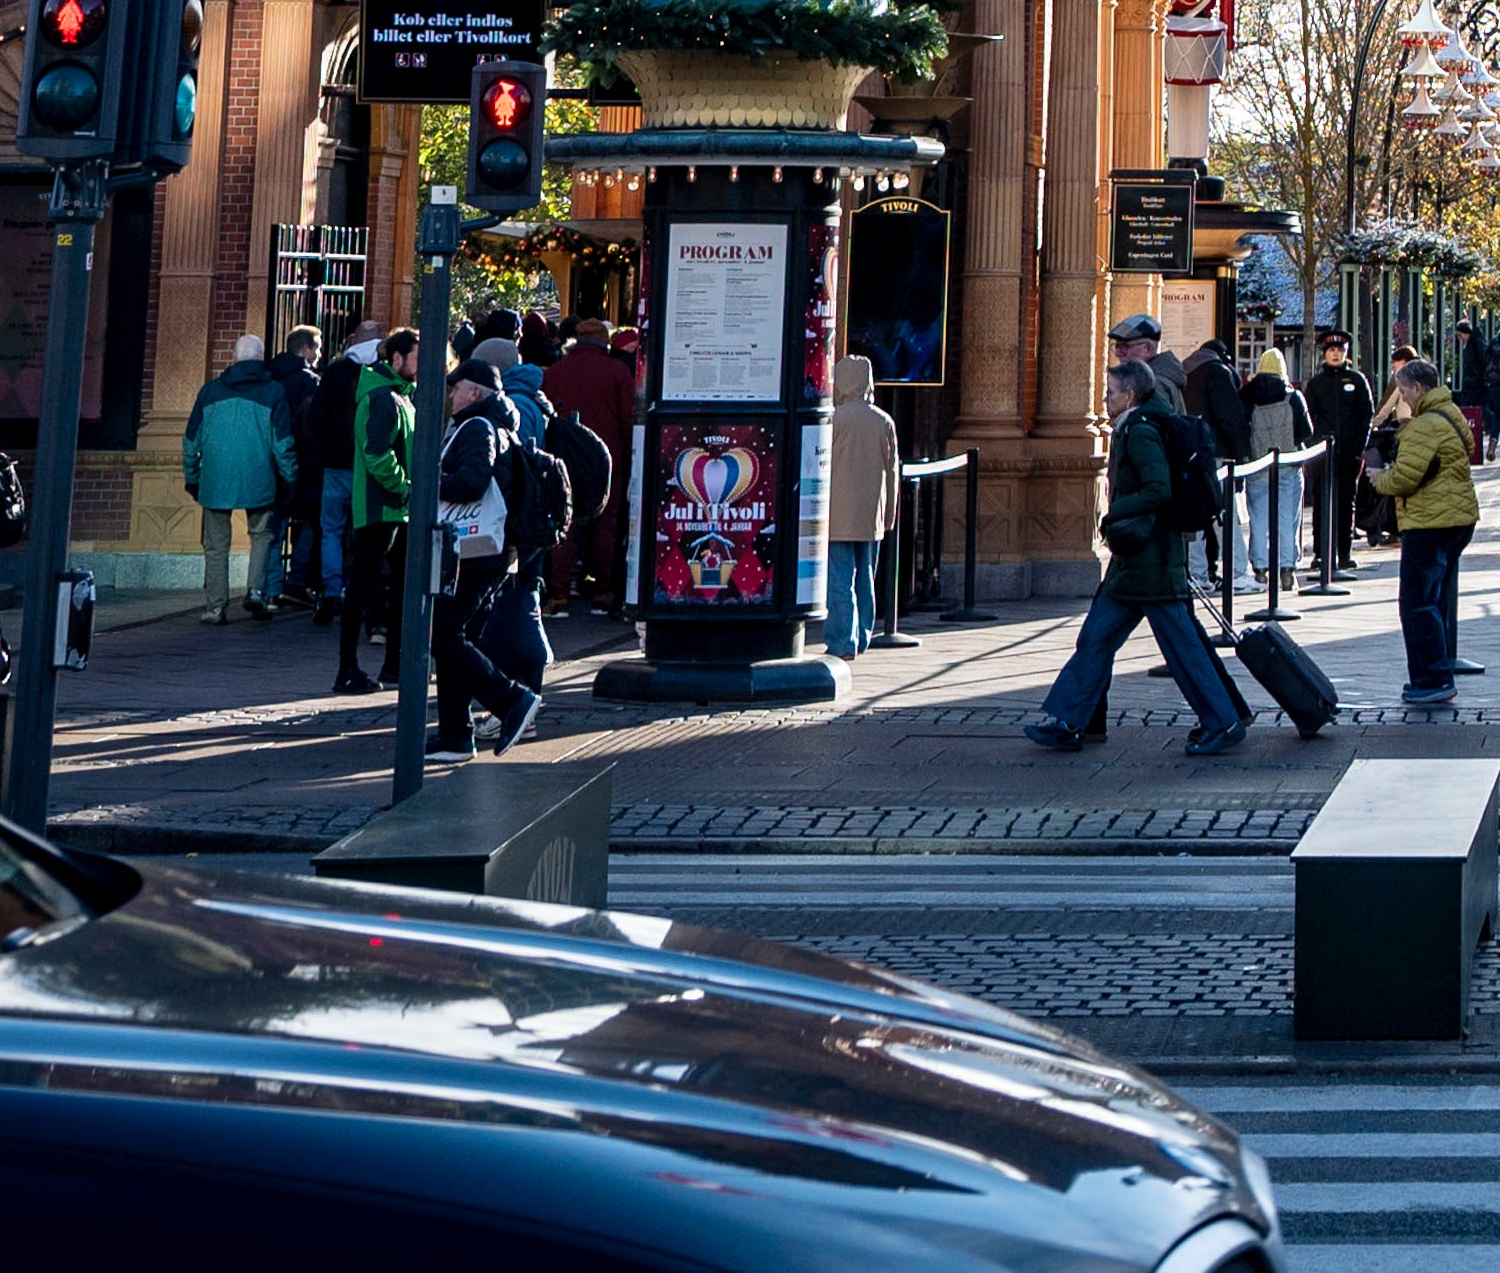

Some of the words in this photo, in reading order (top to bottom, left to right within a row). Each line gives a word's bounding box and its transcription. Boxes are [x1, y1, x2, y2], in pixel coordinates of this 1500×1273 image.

[428, 13, 463, 27] eller
[373, 29, 412, 43] billet
[416, 30, 452, 43] eller
[455, 31, 532, 44] Tivolikort
[881, 201, 919, 213] TIVOLI
[57, 233, 73, 246] 22
[680, 245, 773, 260] PROGRAM
[703, 436, 730, 444] TIVOLI
[664, 502, 693, 520] Jul
[696, 502, 703, 520] i
[707, 502, 766, 520] Tivoli
